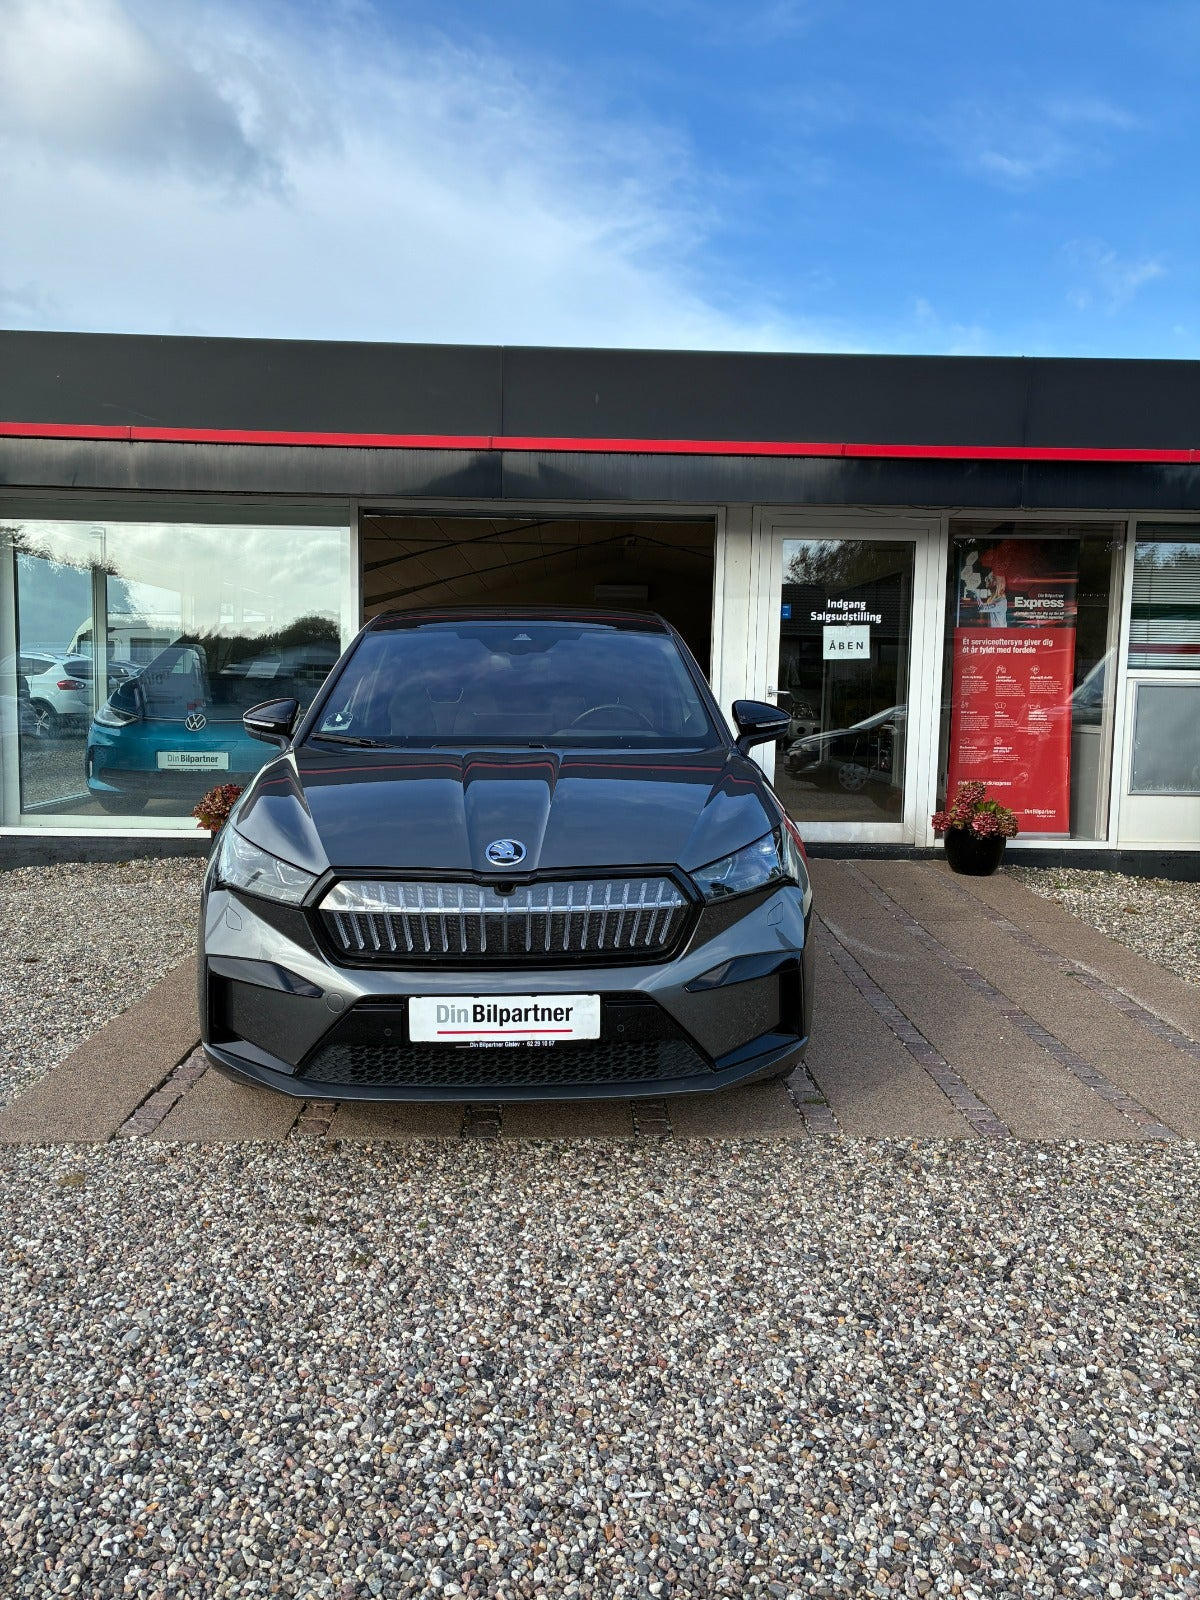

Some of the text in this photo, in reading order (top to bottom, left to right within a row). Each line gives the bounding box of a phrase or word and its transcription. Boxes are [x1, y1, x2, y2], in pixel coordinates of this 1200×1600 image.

[827, 599, 866, 610] Indgang
[1014, 596, 1064, 610] Express
[810, 612, 882, 624] Salgsudstilling
[829, 639, 864, 650] ÅBEN
[971, 638, 1022, 647] serviceeftersyn
[1024, 638, 1040, 647] giver
[1042, 638, 1054, 647] dig
[970, 646, 978, 654] år
[980, 646, 994, 654] fyldt
[180, 754, 218, 764] Bilpartner
[436, 1004, 574, 1026] Din Bilpartner
